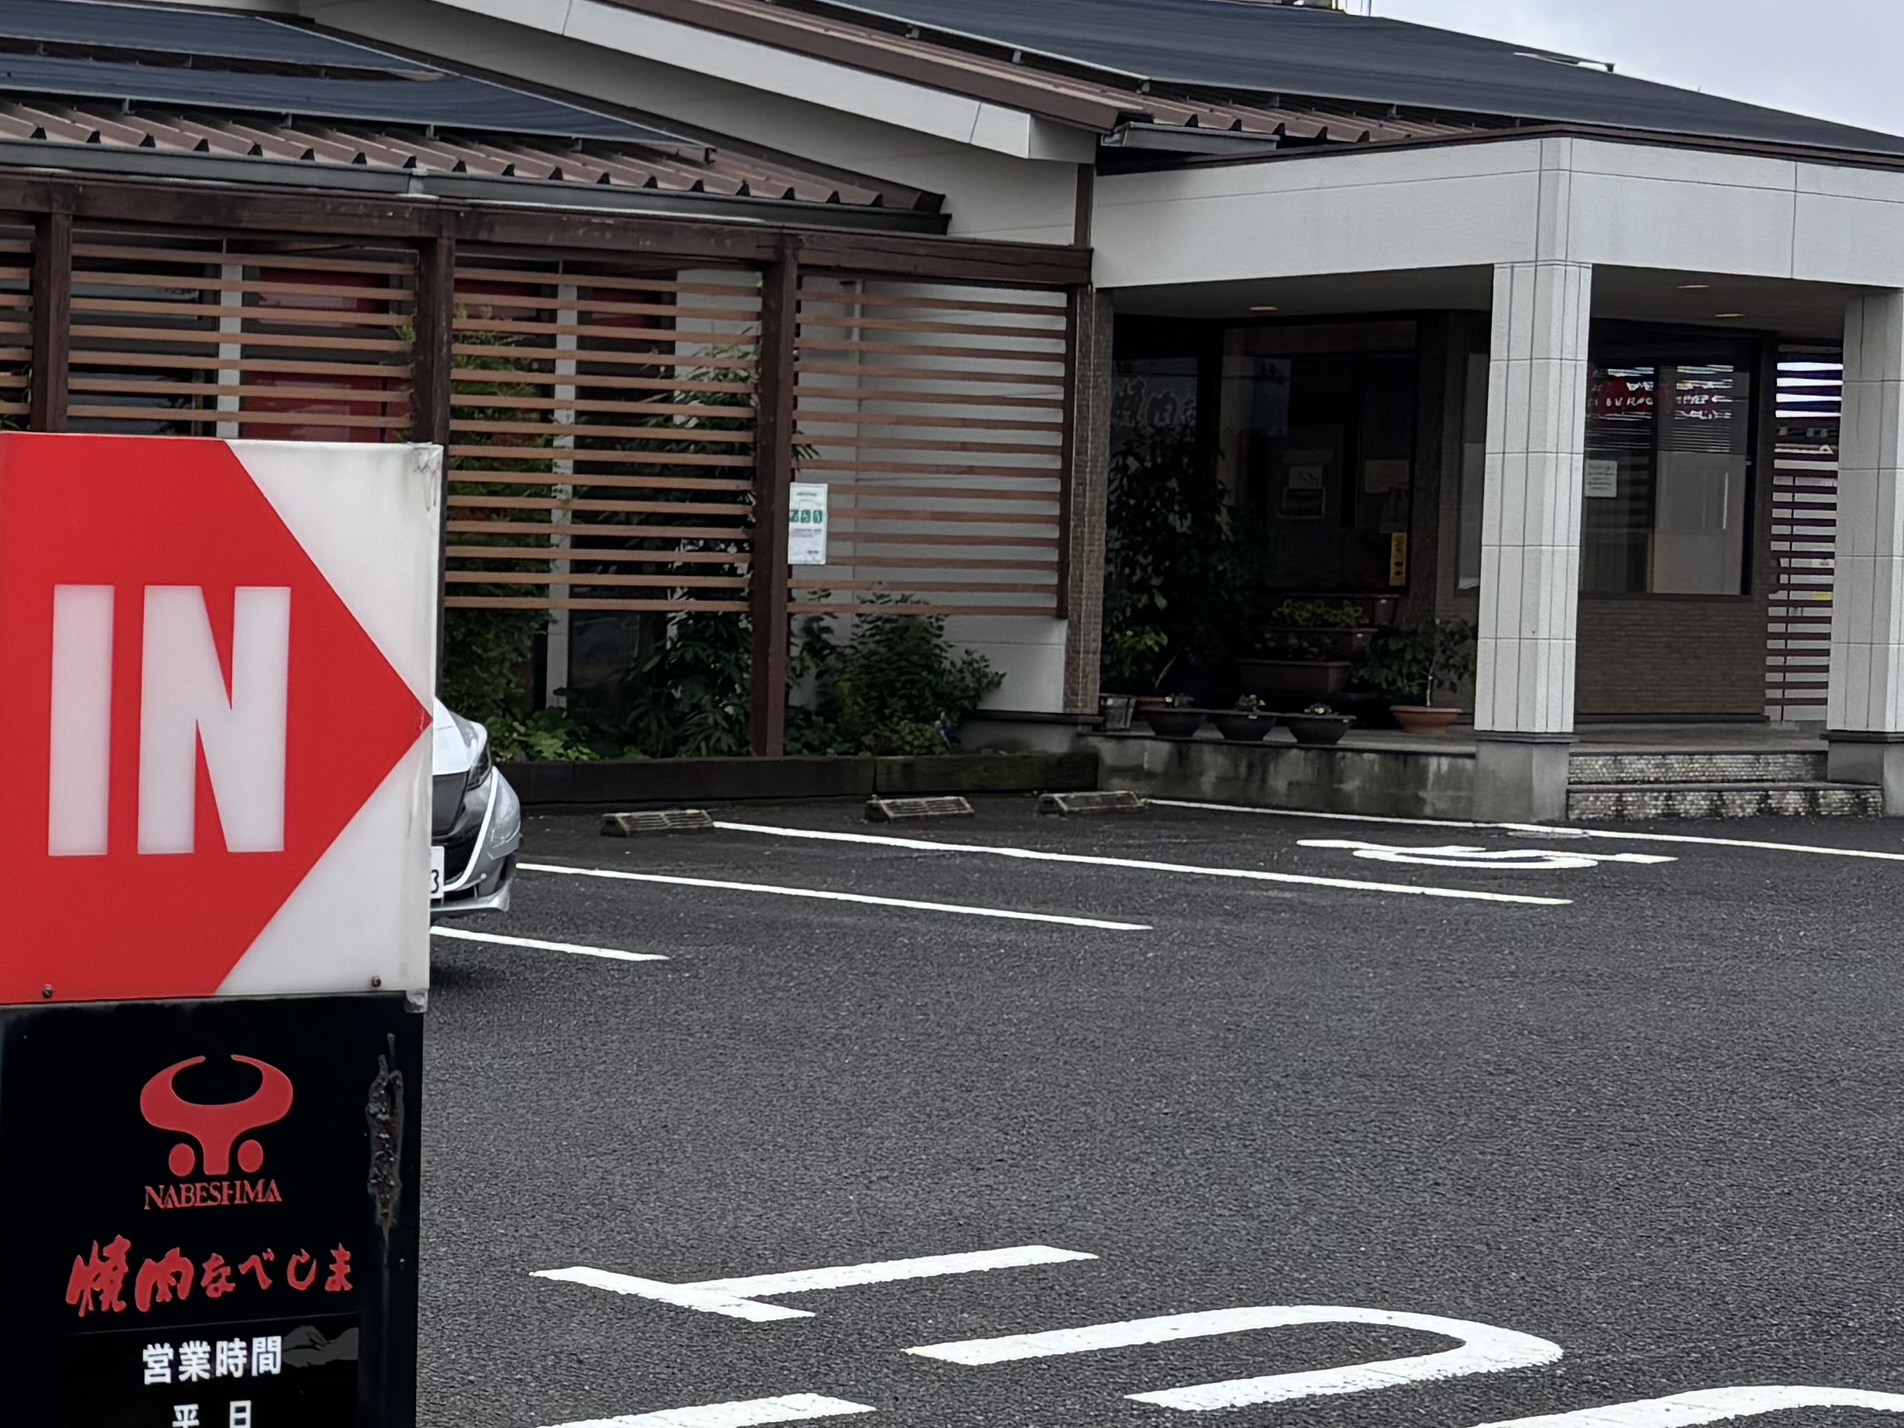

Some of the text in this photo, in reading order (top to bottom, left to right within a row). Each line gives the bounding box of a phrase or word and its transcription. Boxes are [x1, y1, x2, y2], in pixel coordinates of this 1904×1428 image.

[46, 582, 292, 857] IN
[144, 1178, 282, 1210] NABESHIMA
[142, 1335, 283, 1385] 営業時間
